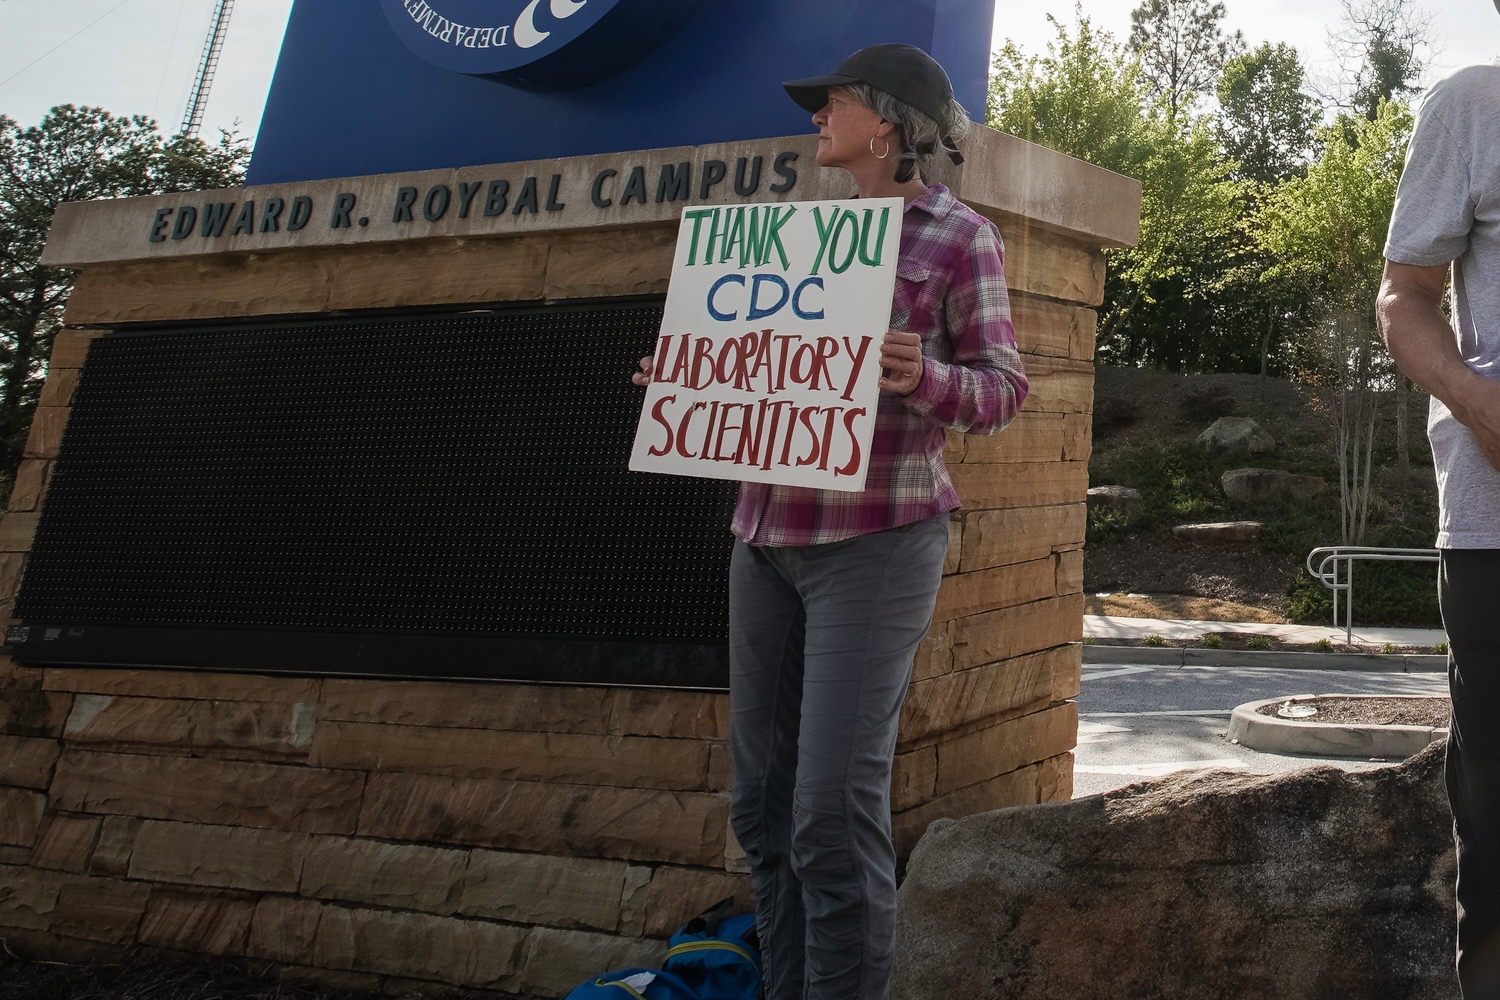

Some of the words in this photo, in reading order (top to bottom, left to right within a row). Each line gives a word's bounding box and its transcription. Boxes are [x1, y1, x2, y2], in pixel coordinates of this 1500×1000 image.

[149, 195, 313, 243] EDWARD
[330, 193, 368, 229] R.
[392, 173, 565, 223] ROYBAL
[590, 151, 799, 209] CAMPUS
[684, 204, 798, 272] THANK
[808, 204, 893, 276] YOU
[706, 273, 825, 323] CDC
[653, 329, 874, 402] LABORATORY
[647, 394, 867, 478] SCIENTISTS
